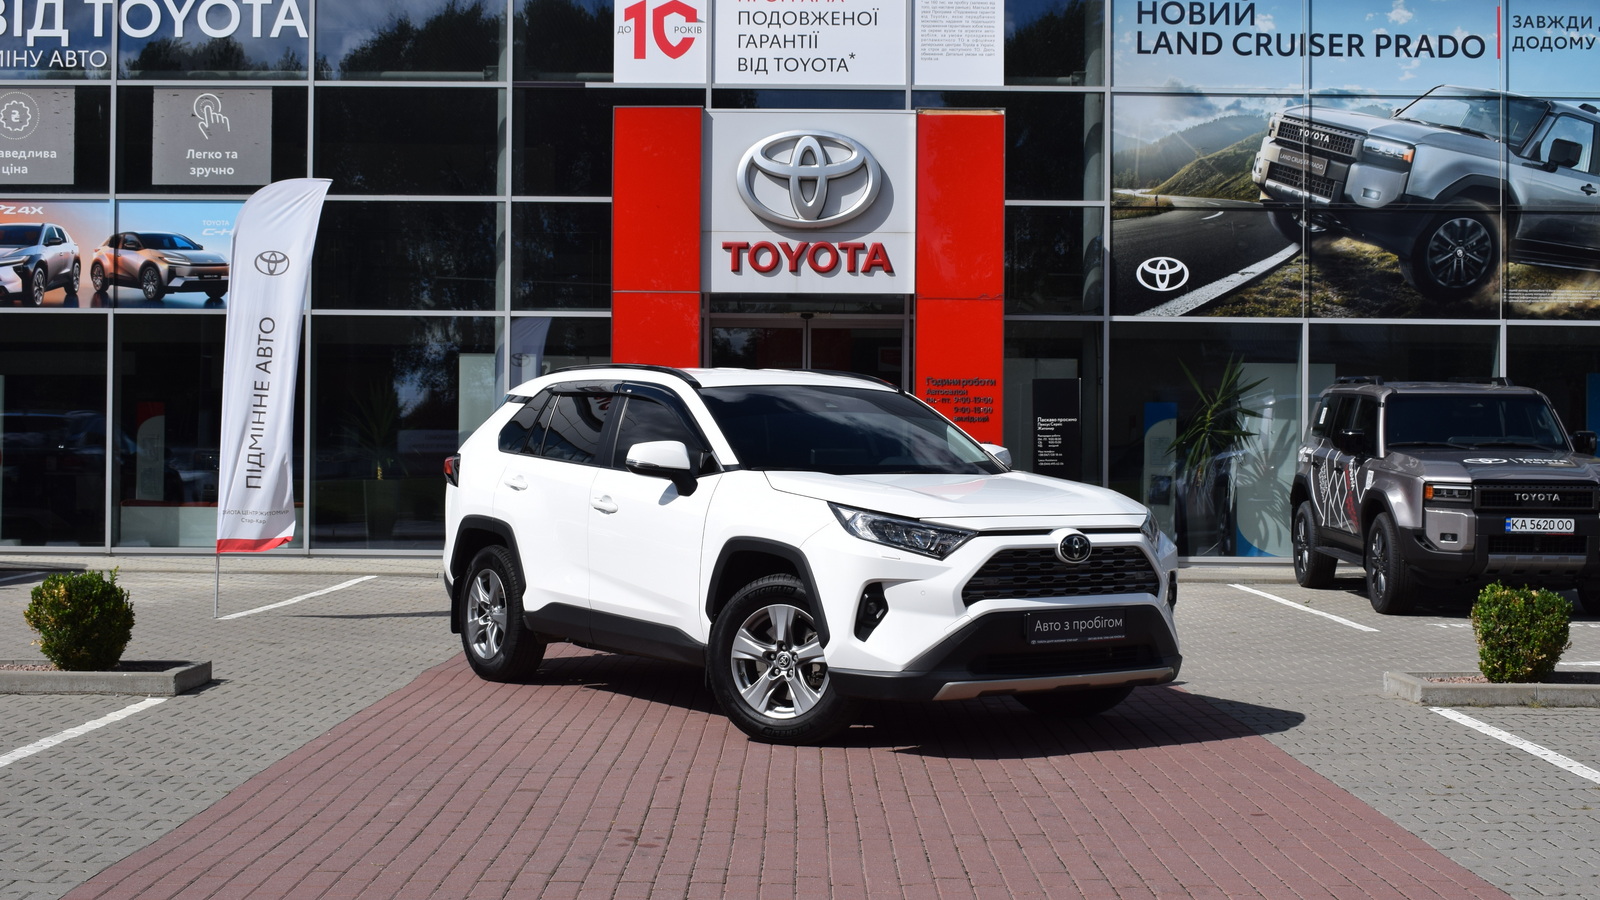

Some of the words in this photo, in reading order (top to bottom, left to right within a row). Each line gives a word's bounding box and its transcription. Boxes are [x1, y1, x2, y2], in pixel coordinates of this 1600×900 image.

[84, 0, 309, 38] TOYOTA
[738, 8, 880, 28] ПОДОВЖЕНОЇ
[1512, 16, 1592, 32] ЗАВЖДИ
[617, 25, 632, 34] ДО
[674, 26, 703, 34] РОКІВ
[738, 30, 820, 48] ГАРАНТІЇ
[1137, 31, 1223, 55] LAND
[1232, 32, 1364, 57] CRUISER
[1376, 34, 1486, 59] PRADO
[1512, 36, 1596, 52] ДОДОМУ
[48, 49, 107, 68] АВТО
[738, 58, 768, 75] ВІД
[186, 148, 222, 159] Легко
[224, 151, 238, 159] та
[2, 163, 28, 176] ціна
[190, 167, 234, 177] зручно
[722, 240, 894, 273] TOYOTA
[256, 316, 276, 374] АВТО
[926, 376, 960, 387] Години
[962, 376, 996, 388] роботи
[246, 380, 270, 489] ПІДМІННЕ
[1514, 493, 1560, 501] TOYOTA
[1512, 519, 1527, 530] KA
[1530, 520, 1555, 530] 5620
[1034, 620, 1061, 632] Авто
[1064, 622, 1070, 631] з
[1072, 616, 1123, 632] пробігом
